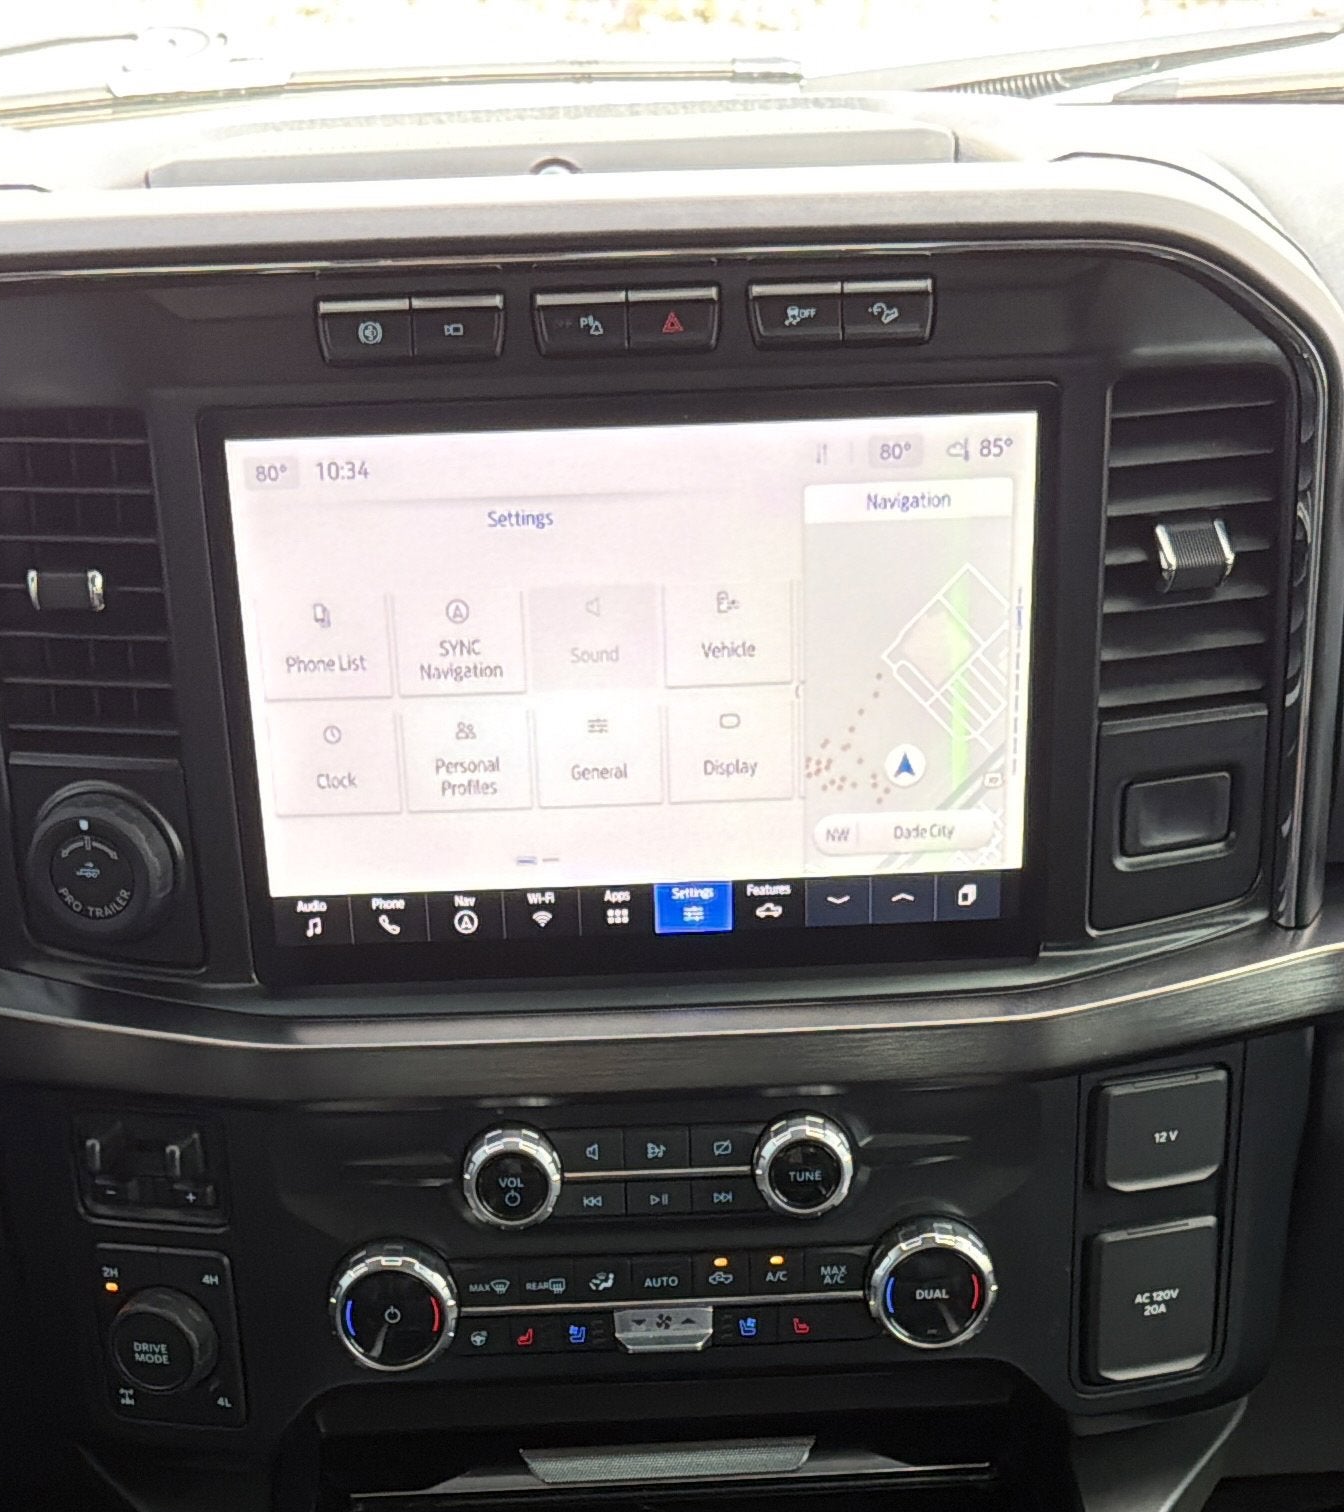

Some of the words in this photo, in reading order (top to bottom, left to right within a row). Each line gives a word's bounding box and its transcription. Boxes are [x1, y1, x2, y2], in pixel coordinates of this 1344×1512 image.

[799, 308, 817, 319] OFF
[315, 460, 370, 481] 10:34
[866, 493, 952, 512] Navigation
[487, 510, 554, 530] Settings
[439, 639, 481, 657] SYNC
[570, 645, 620, 664] Sound
[701, 641, 756, 659] Vehicle
[286, 656, 336, 673] Phone
[338, 654, 367, 672] List
[419, 662, 504, 682] Navigation
[435, 756, 500, 775] Personal
[571, 763, 628, 781] General
[703, 759, 758, 778] Display
[316, 772, 357, 790] Clock
[441, 779, 498, 797] Profiles
[826, 828, 850, 843] NW
[929, 823, 955, 840] City
[604, 889, 631, 904] Apps
[671, 887, 715, 901] Settings
[746, 883, 792, 897] Features
[58, 887, 83, 913] PRO
[87, 887, 132, 919] TRAILER
[296, 900, 327, 913] Audio
[371, 897, 405, 911] Phone
[454, 894, 476, 908] Nav
[1154, 1131, 1168, 1144] 12
[1168, 1129, 1179, 1142] V
[498, 1177, 524, 1189] VOL
[788, 1170, 822, 1183] TUNE
[102, 1266, 119, 1278] 2H
[765, 1270, 788, 1283] A/C
[820, 1265, 847, 1277] MAX
[202, 1275, 219, 1286] 4H
[526, 1281, 549, 1291] REAR
[643, 1275, 679, 1288] AUTO
[823, 1273, 846, 1285] A/C
[469, 1284, 491, 1293] MAX
[915, 1289, 949, 1300] DUAL
[1134, 1291, 1151, 1304] AC
[1152, 1288, 1179, 1302] 120V
[1144, 1303, 1166, 1316] 20A
[133, 1341, 168, 1354] DRIVE
[135, 1353, 170, 1365] MODE
[217, 1397, 232, 1409] 4L
